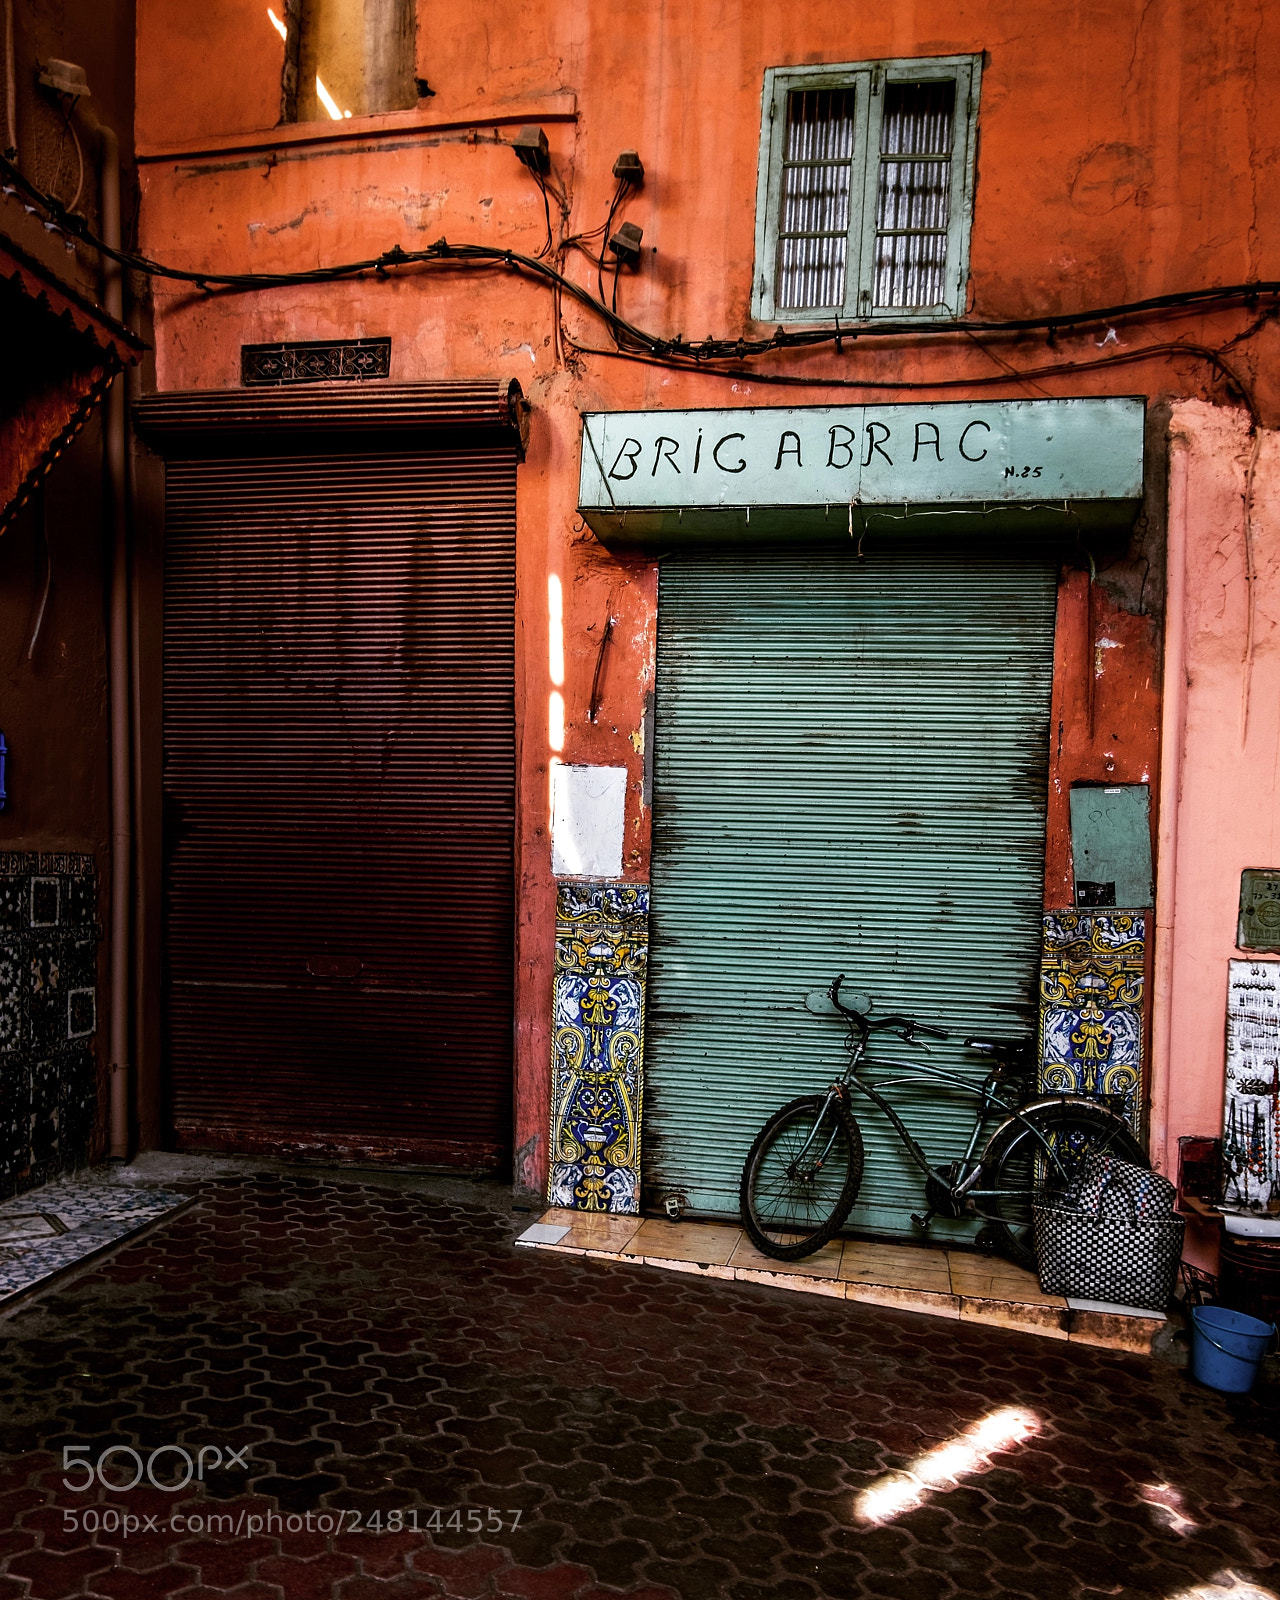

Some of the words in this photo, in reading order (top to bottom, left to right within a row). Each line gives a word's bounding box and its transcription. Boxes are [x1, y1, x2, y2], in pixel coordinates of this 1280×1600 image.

[774, 431, 803, 470] A
[826, 420, 991, 469] BRAC
[1004, 465, 1044, 479] N.25
